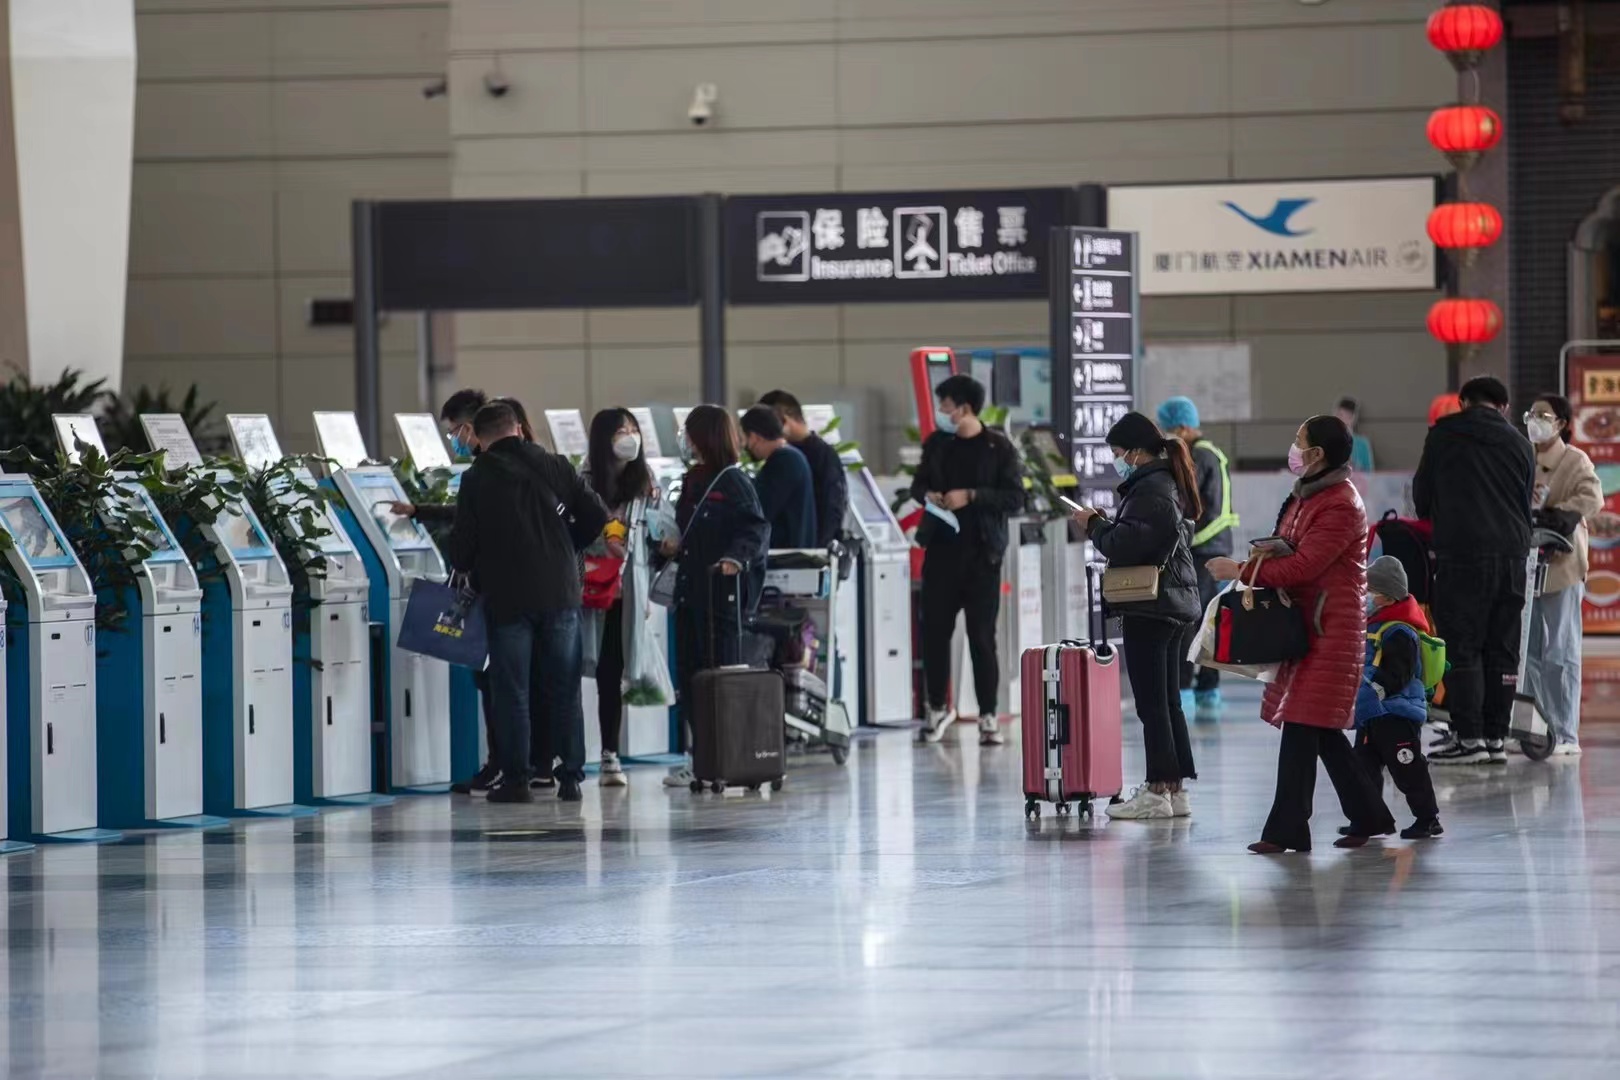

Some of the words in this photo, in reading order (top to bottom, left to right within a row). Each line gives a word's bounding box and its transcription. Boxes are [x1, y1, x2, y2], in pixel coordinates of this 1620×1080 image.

[812, 206, 889, 250] 保险
[954, 206, 1028, 248] 售票
[811, 255, 893, 279] Insurance
[949, 252, 992, 276] Ticket
[993, 251, 1037, 275] Office
